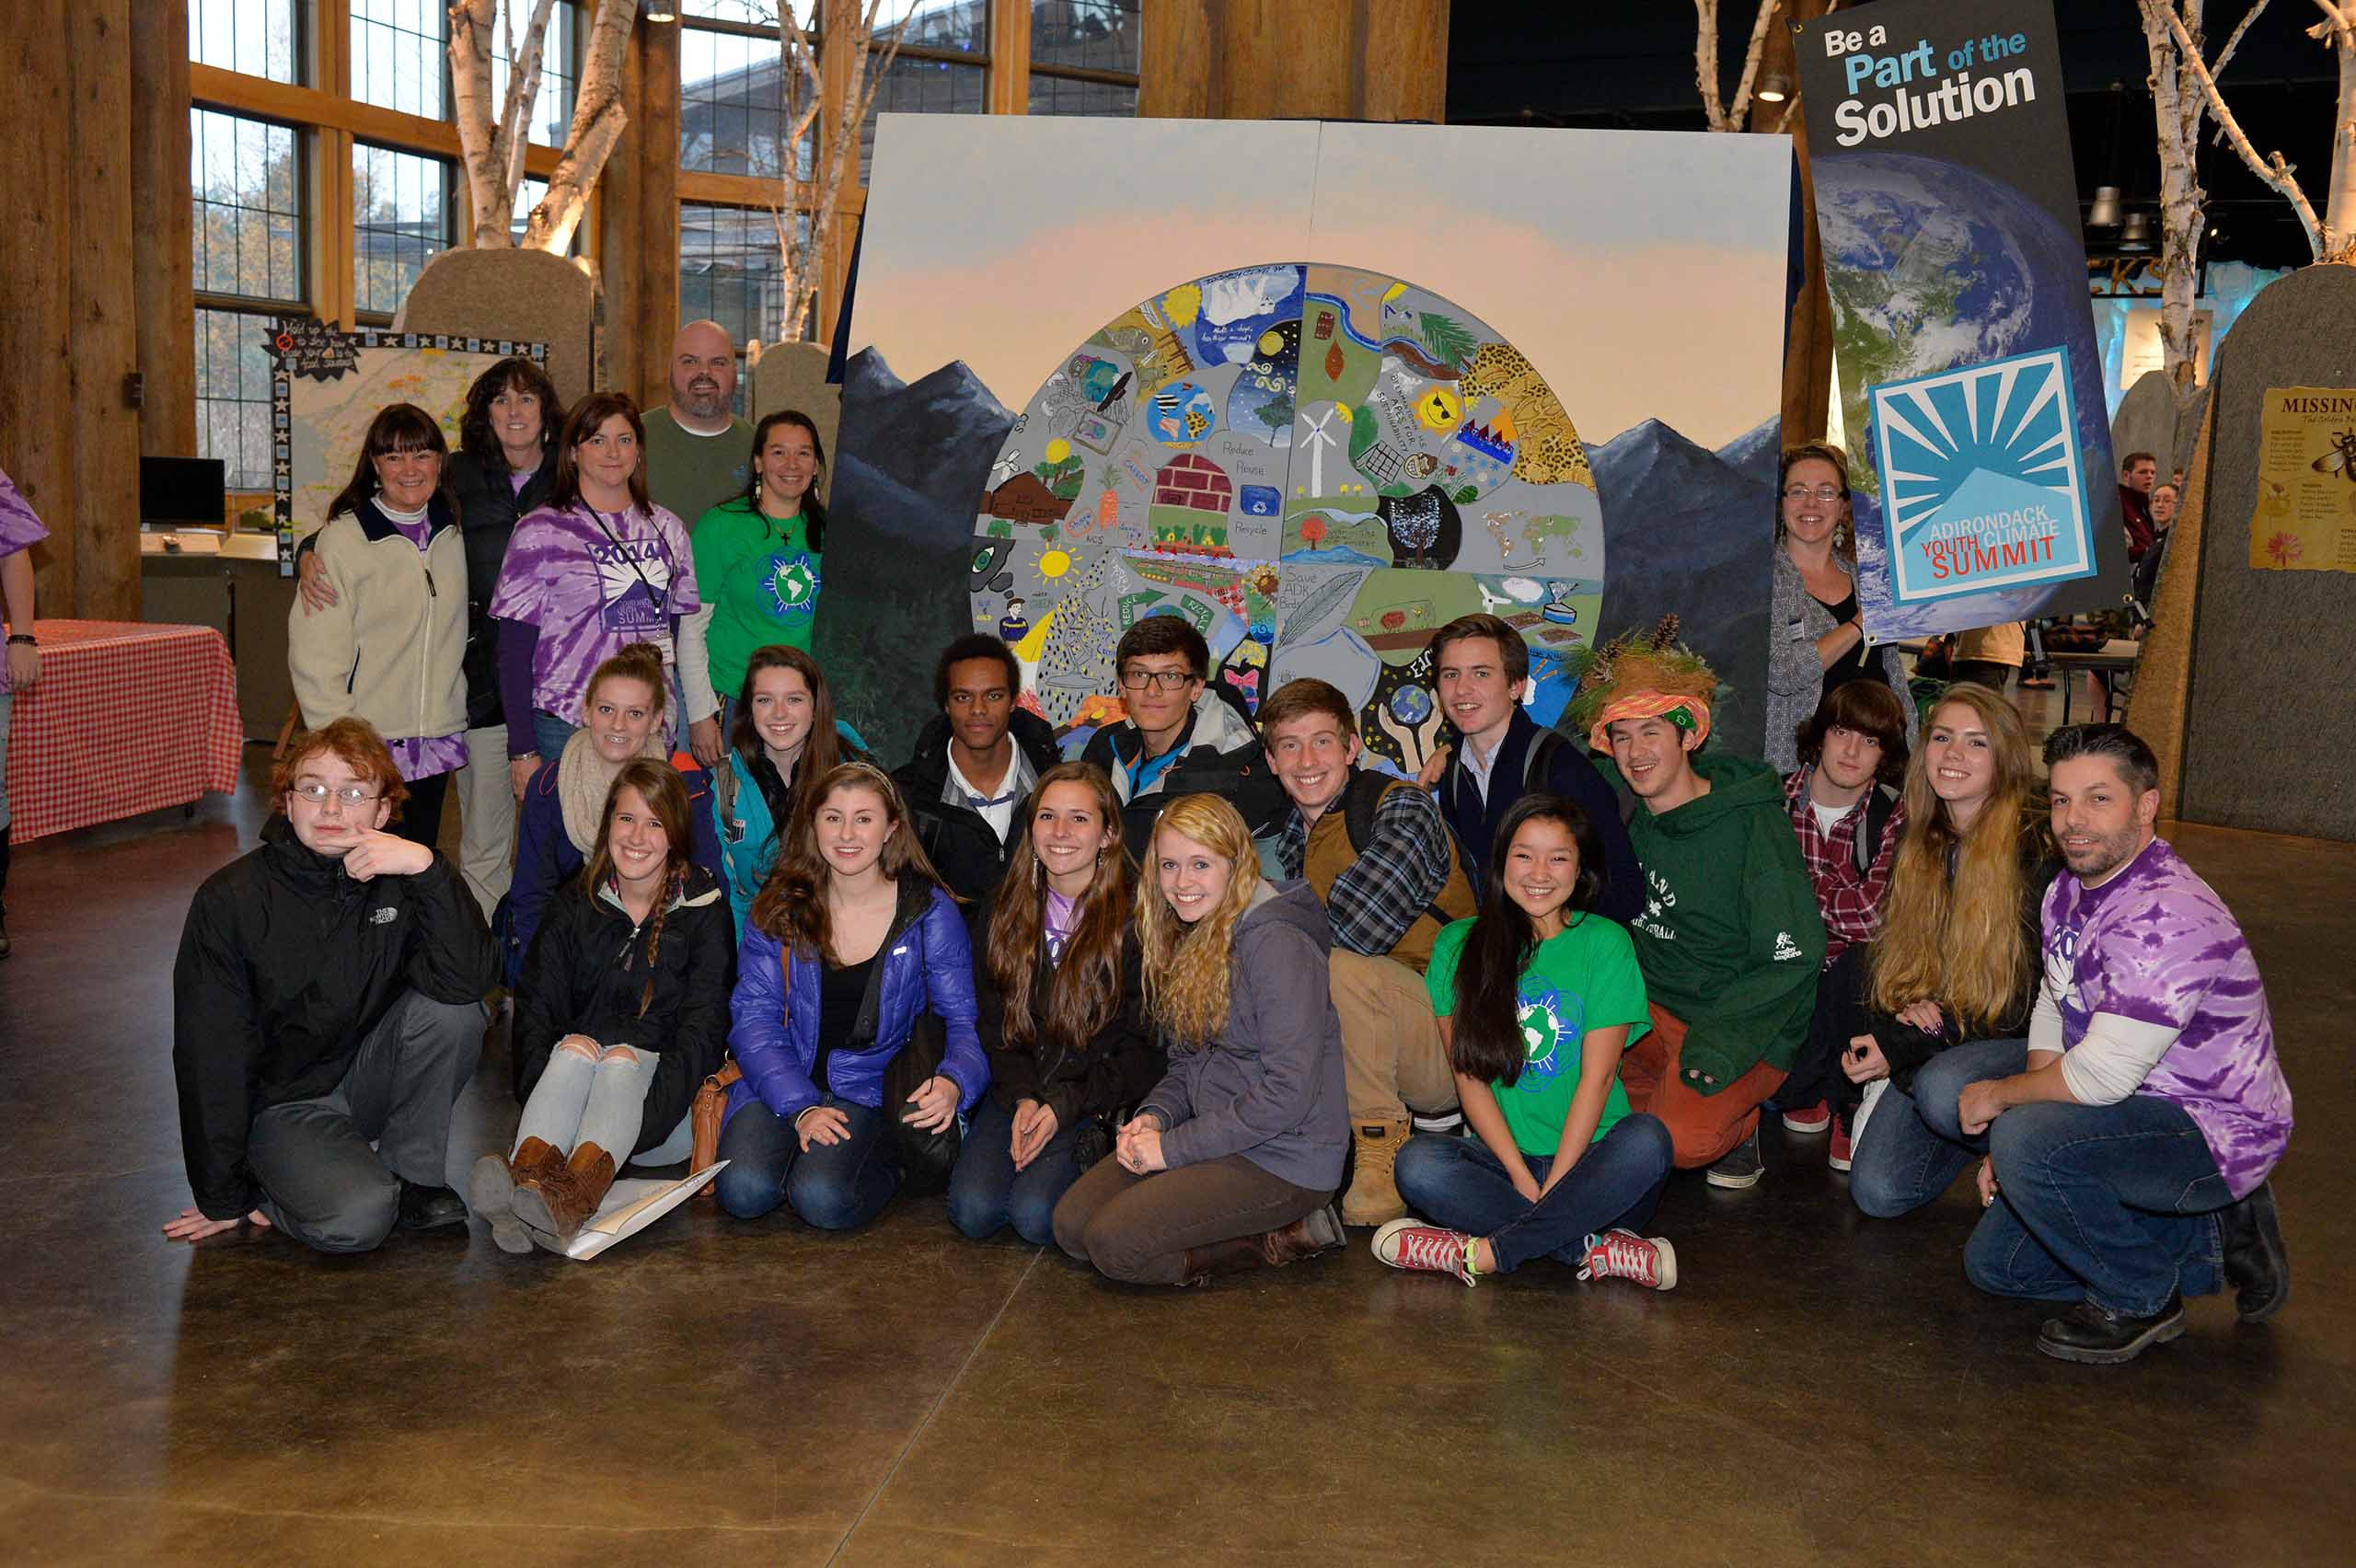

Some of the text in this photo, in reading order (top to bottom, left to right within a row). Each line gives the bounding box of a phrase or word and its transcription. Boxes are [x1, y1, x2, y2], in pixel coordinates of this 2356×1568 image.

[1825, 25, 1887, 58] Be a
[1845, 32, 2027, 95] Part of the
[1834, 67, 2036, 147] Solution
[2281, 398, 2356, 413] MISSIN
[1403, 425, 1415, 443] FOR
[1921, 519, 2061, 558] YOUTH CLIMATE
[1929, 503, 2050, 541] ADIRONDACK
[595, 543, 660, 565] 2014
[1932, 536, 2056, 580] SUMMIT
[1285, 583, 1309, 596] ADK
[1286, 567, 1317, 582] Save
[1123, 594, 1138, 626] REDUCE
[1188, 600, 1209, 633] RECYCLE
